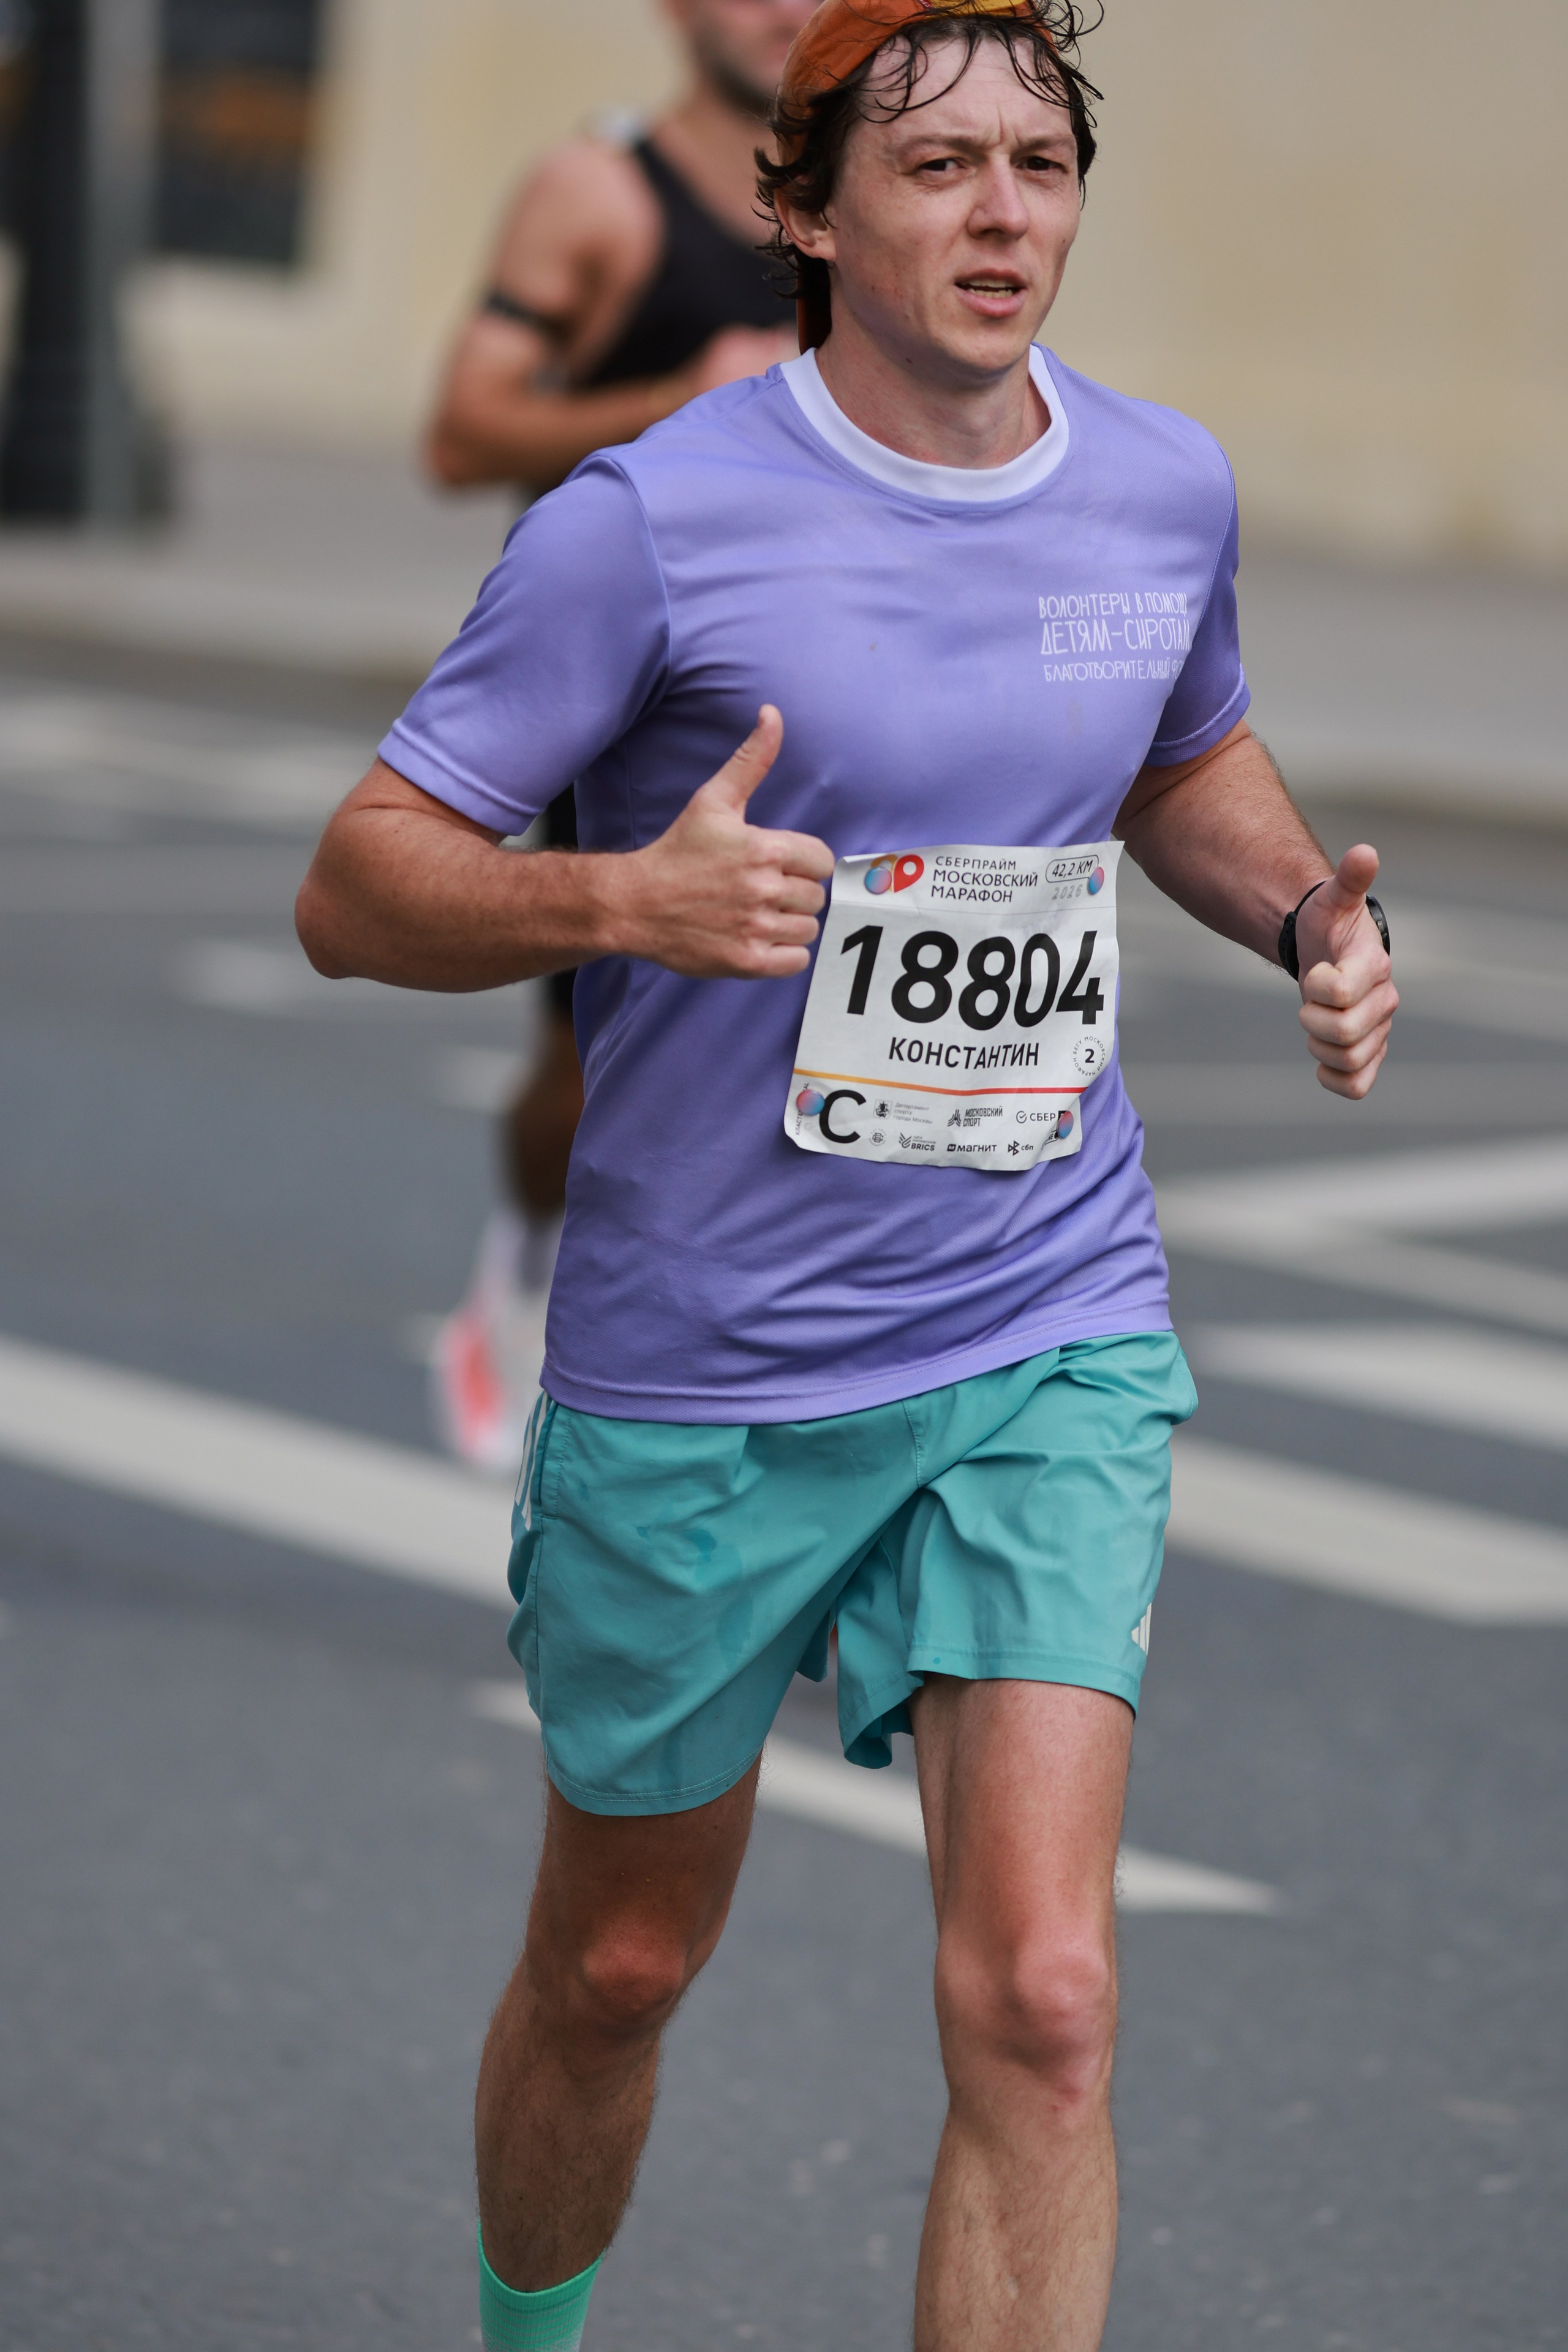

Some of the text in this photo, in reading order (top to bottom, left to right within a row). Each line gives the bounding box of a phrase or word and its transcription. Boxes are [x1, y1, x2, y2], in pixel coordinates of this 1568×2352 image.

[1039, 592, 1130, 619] ВОЛОНТЕРЫ
[1135, 593, 1144, 613] В
[1041, 618, 1189, 655] ДЕТЯМ-СИРОТАМ
[1043, 657, 1170, 682] БЛАГОТВОРИТЕЛЬНЫЙ
[935, 856, 1016, 870] СБЕРПРАЙМ
[1052, 863, 1074, 878] 42,2
[933, 869, 1038, 887] МОСКОВСКИЙ
[931, 885, 1012, 903] МАРАФОН
[1051, 884, 1083, 900] 2026
[841, 925, 1104, 1031] 18804
[888, 1036, 1039, 1069] КОНСТАНТИН
[1085, 1048, 1095, 1063] 2
[895, 1102, 929, 1111] Департамент
[965, 1106, 1003, 1117] МОСКОВСКИЙ
[963, 1117, 981, 1127] СПОРТ
[1030, 1113, 1056, 1121] СБЕР
[911, 1142, 935, 1152] BRICS
